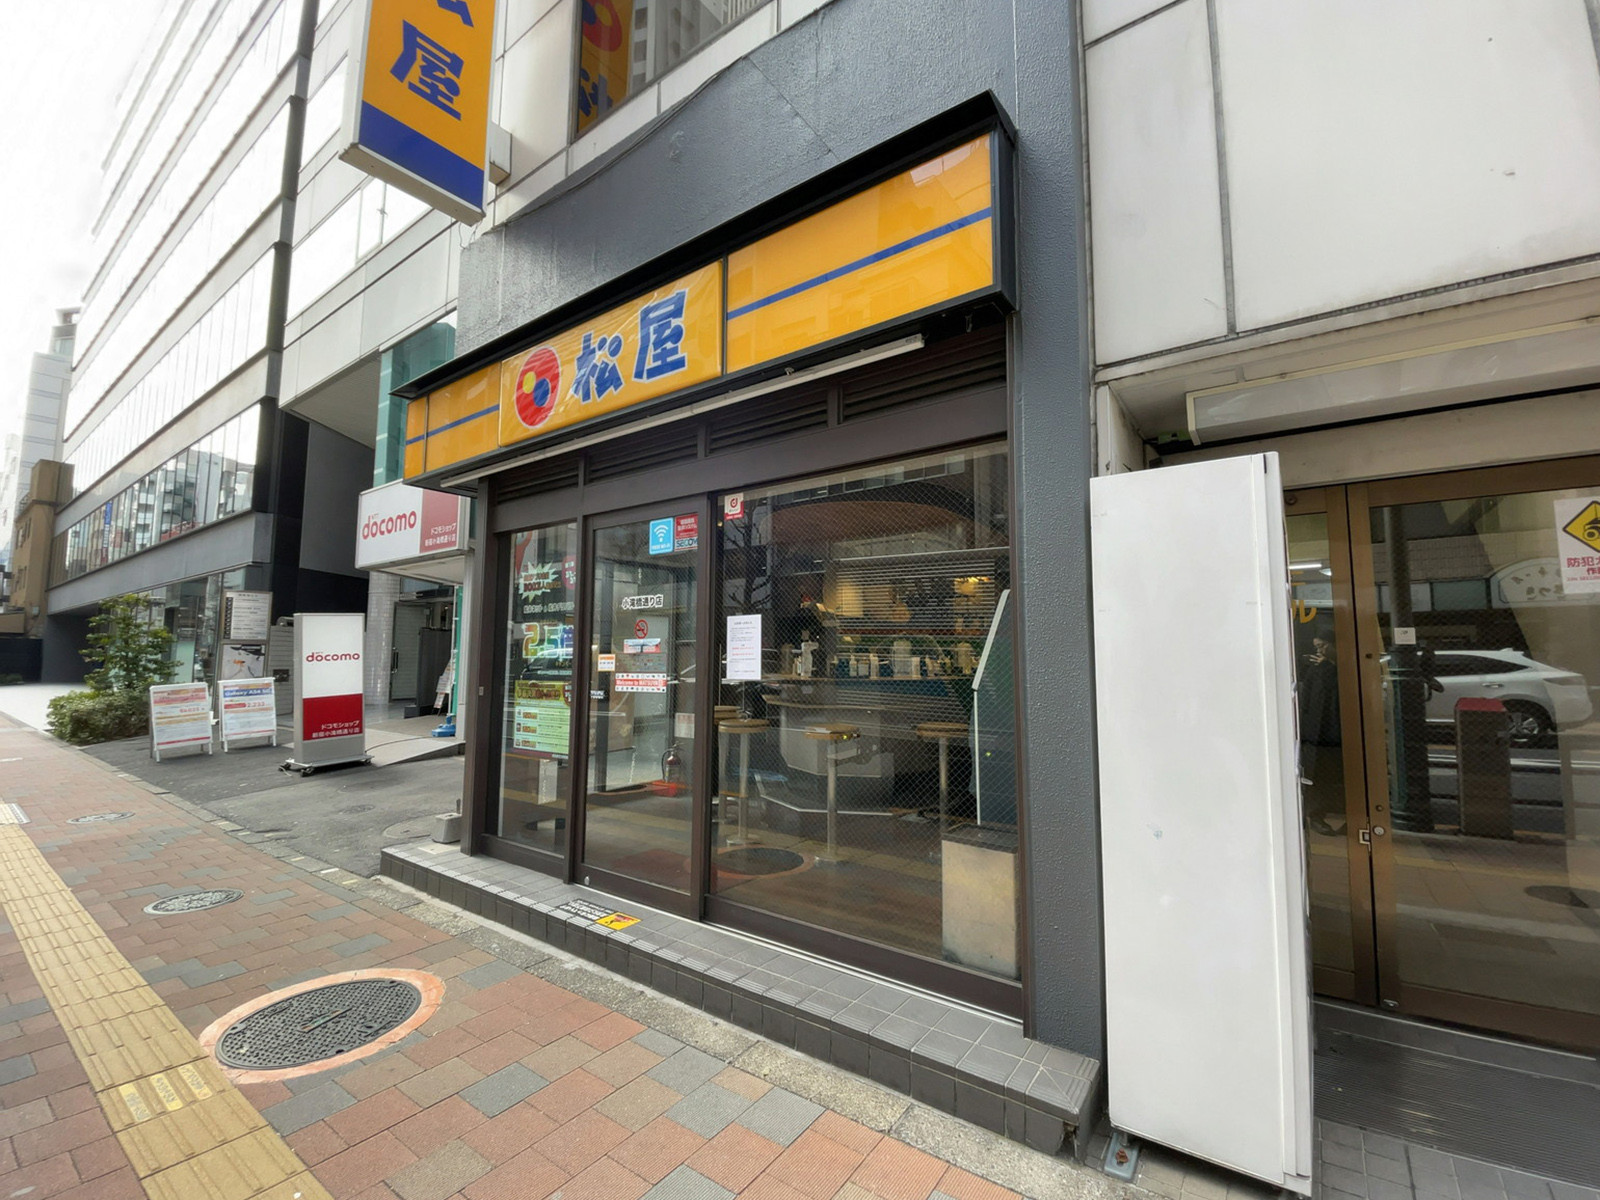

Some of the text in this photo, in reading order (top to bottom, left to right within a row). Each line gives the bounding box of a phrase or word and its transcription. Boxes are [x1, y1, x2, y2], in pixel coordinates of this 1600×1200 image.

[390, 0, 474, 121] 屋
[572, 288, 689, 404] 松屋
[362, 510, 417, 540] docomo
[621, 594, 664, 610] 小滝橋通り店
[306, 652, 360, 662] docomo
[321, 720, 360, 730] ドコモショップ
